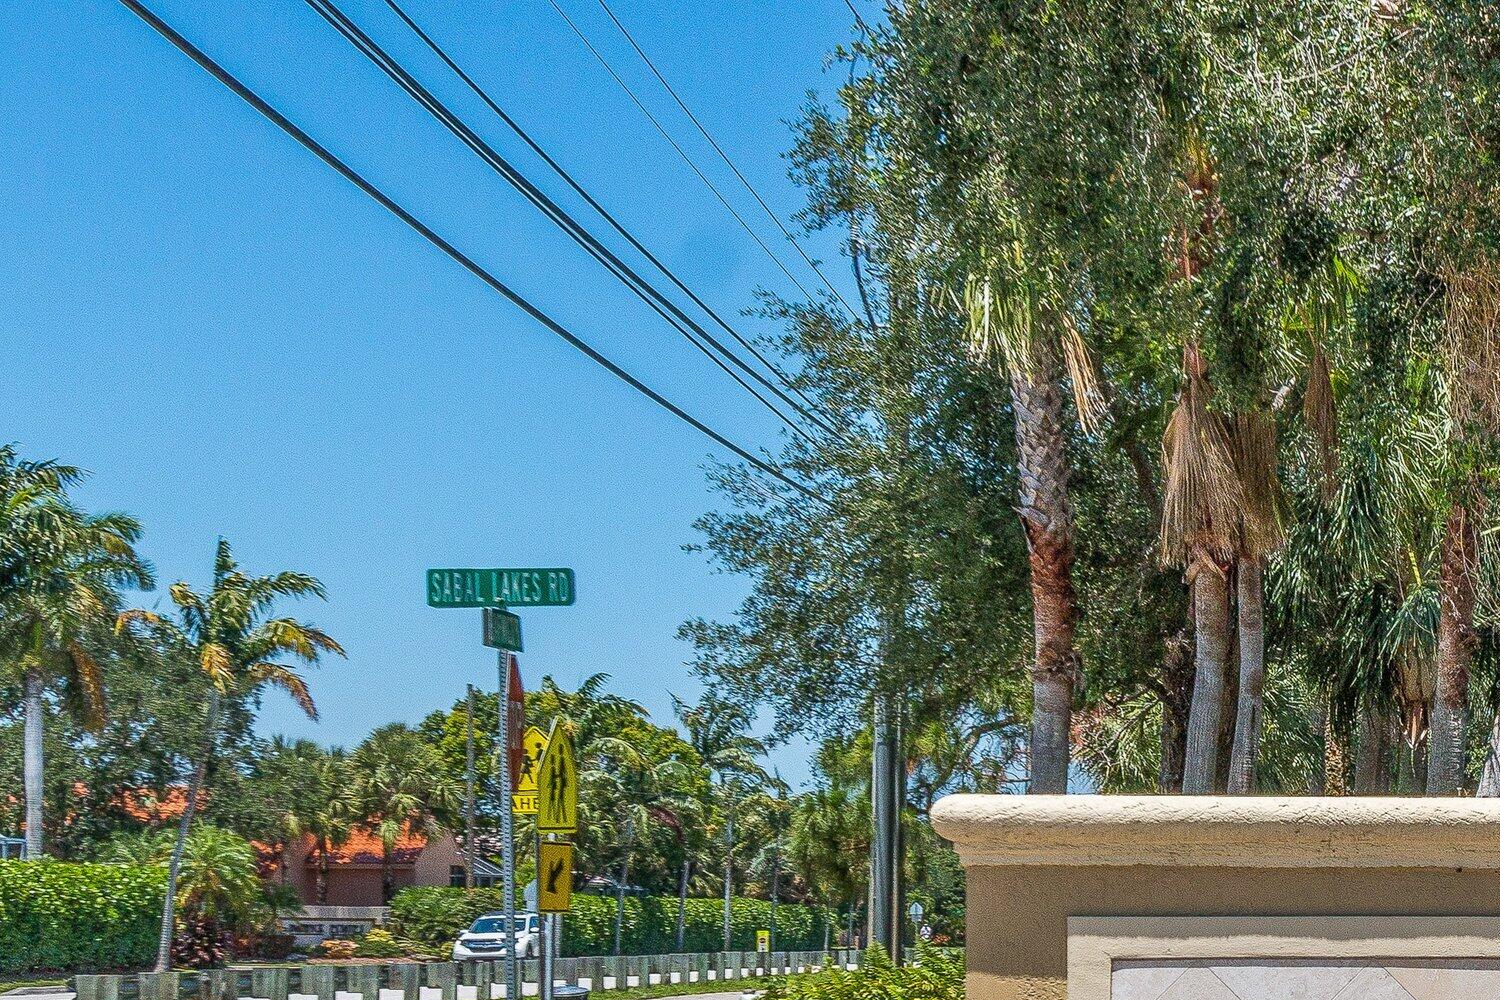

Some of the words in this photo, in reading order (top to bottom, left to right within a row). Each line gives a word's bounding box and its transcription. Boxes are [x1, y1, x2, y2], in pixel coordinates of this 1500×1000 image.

[431, 571, 485, 602] SABAL
[491, 571, 543, 602] LAKES
[548, 571, 570, 602] RD
